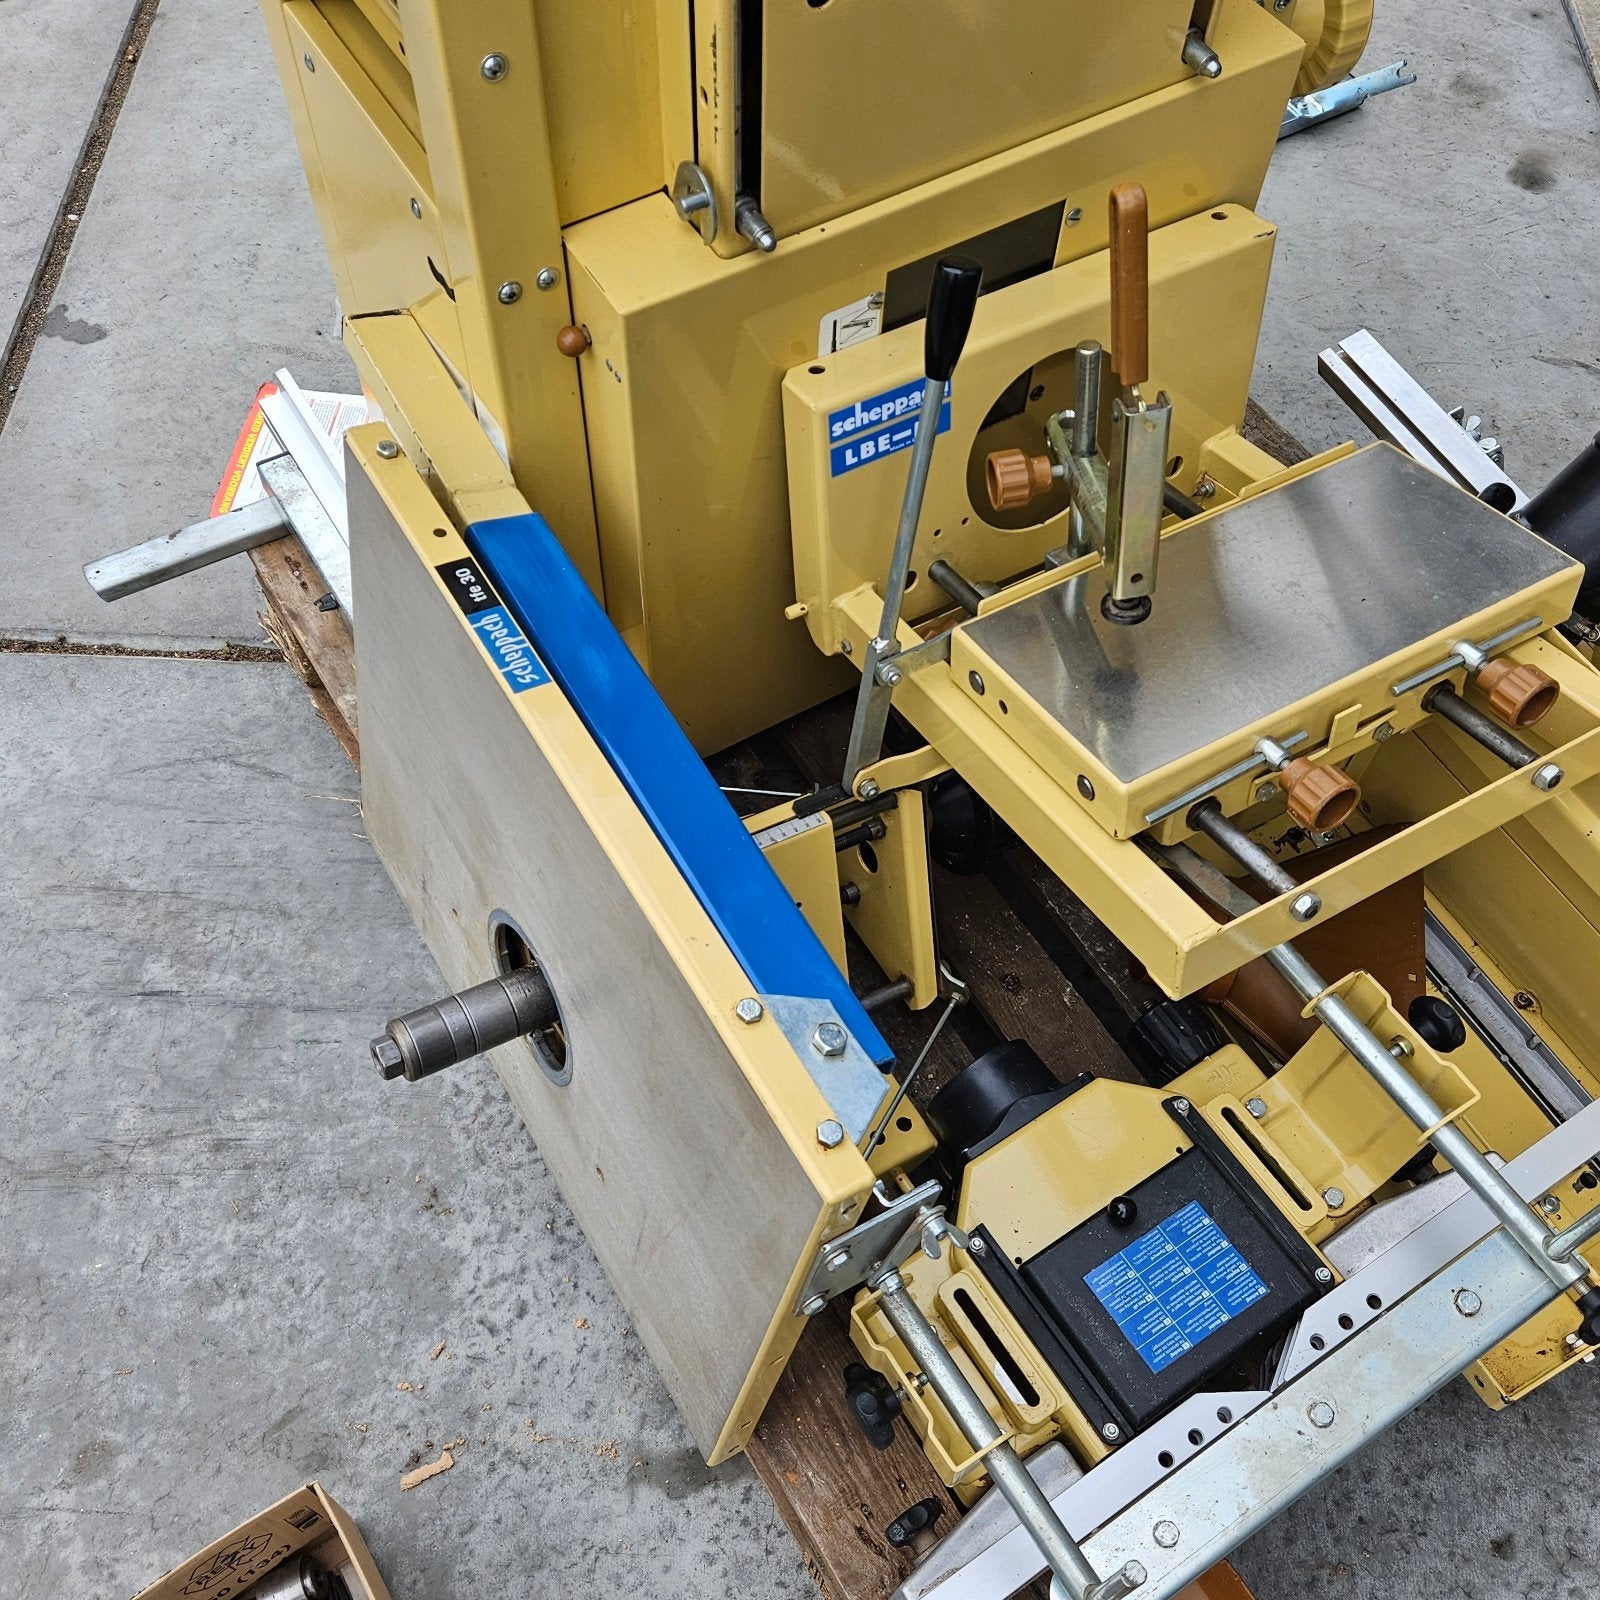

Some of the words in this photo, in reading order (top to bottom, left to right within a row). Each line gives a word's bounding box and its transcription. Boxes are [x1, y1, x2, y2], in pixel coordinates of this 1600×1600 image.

[831, 380, 950, 437] scheppa
[237, 434, 257, 469] VERDIENT
[455, 567, 476, 585] 30
[472, 613, 540, 684] scheppach
